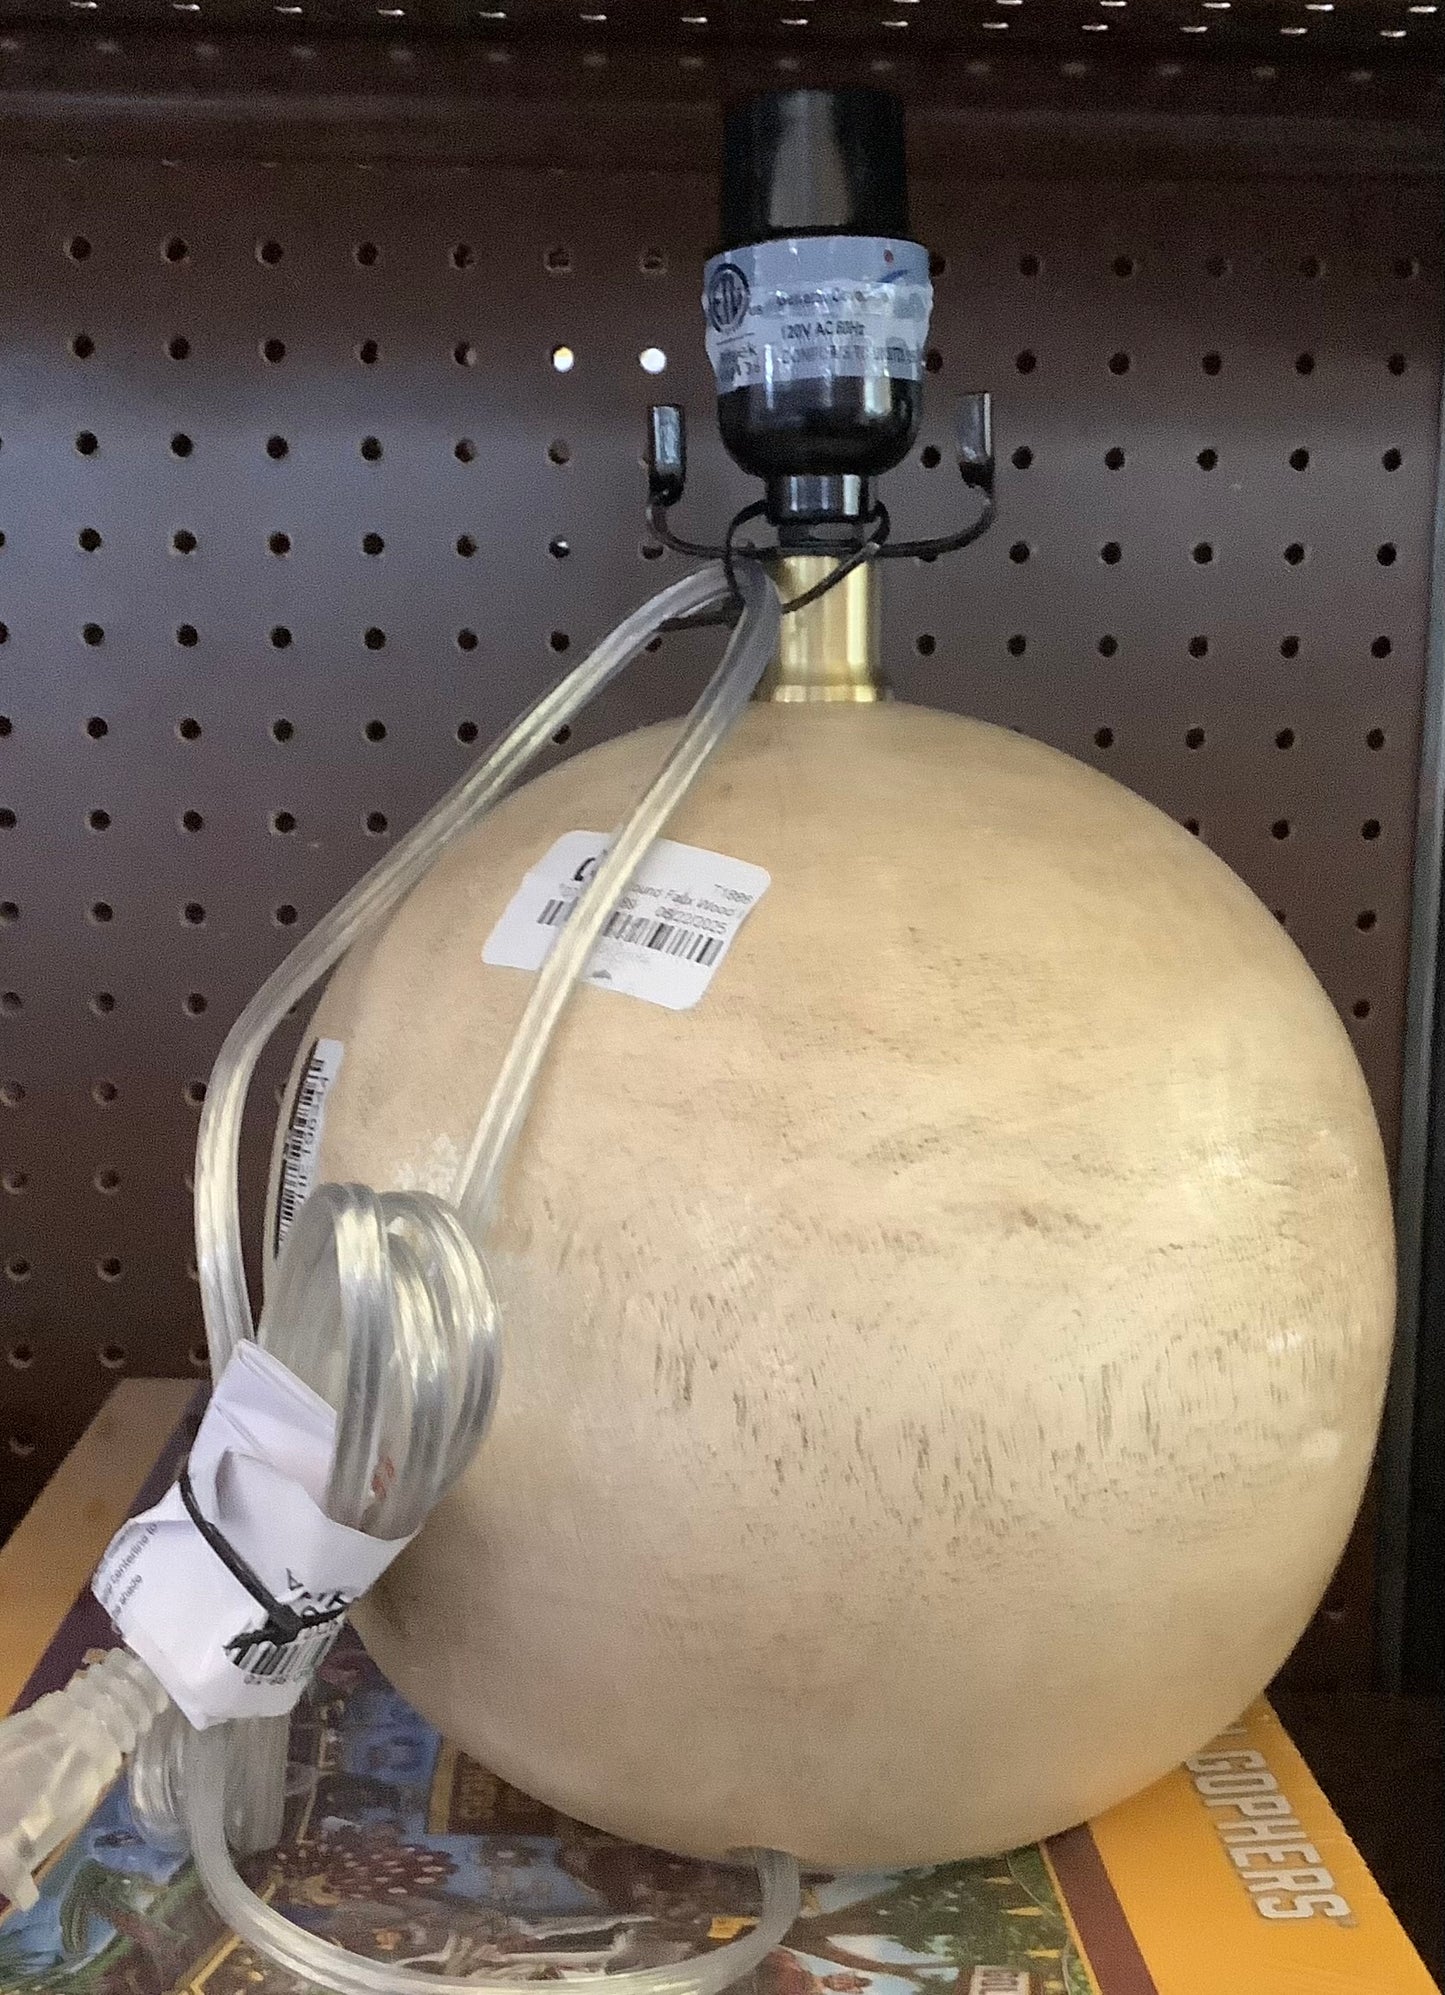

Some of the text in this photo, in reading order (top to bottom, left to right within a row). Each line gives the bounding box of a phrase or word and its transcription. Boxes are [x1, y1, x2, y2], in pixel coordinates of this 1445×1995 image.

[781, 321, 813, 339] 120V
[815, 319, 833, 337] AC
[1186, 1749, 1351, 1920] GOPHERS
